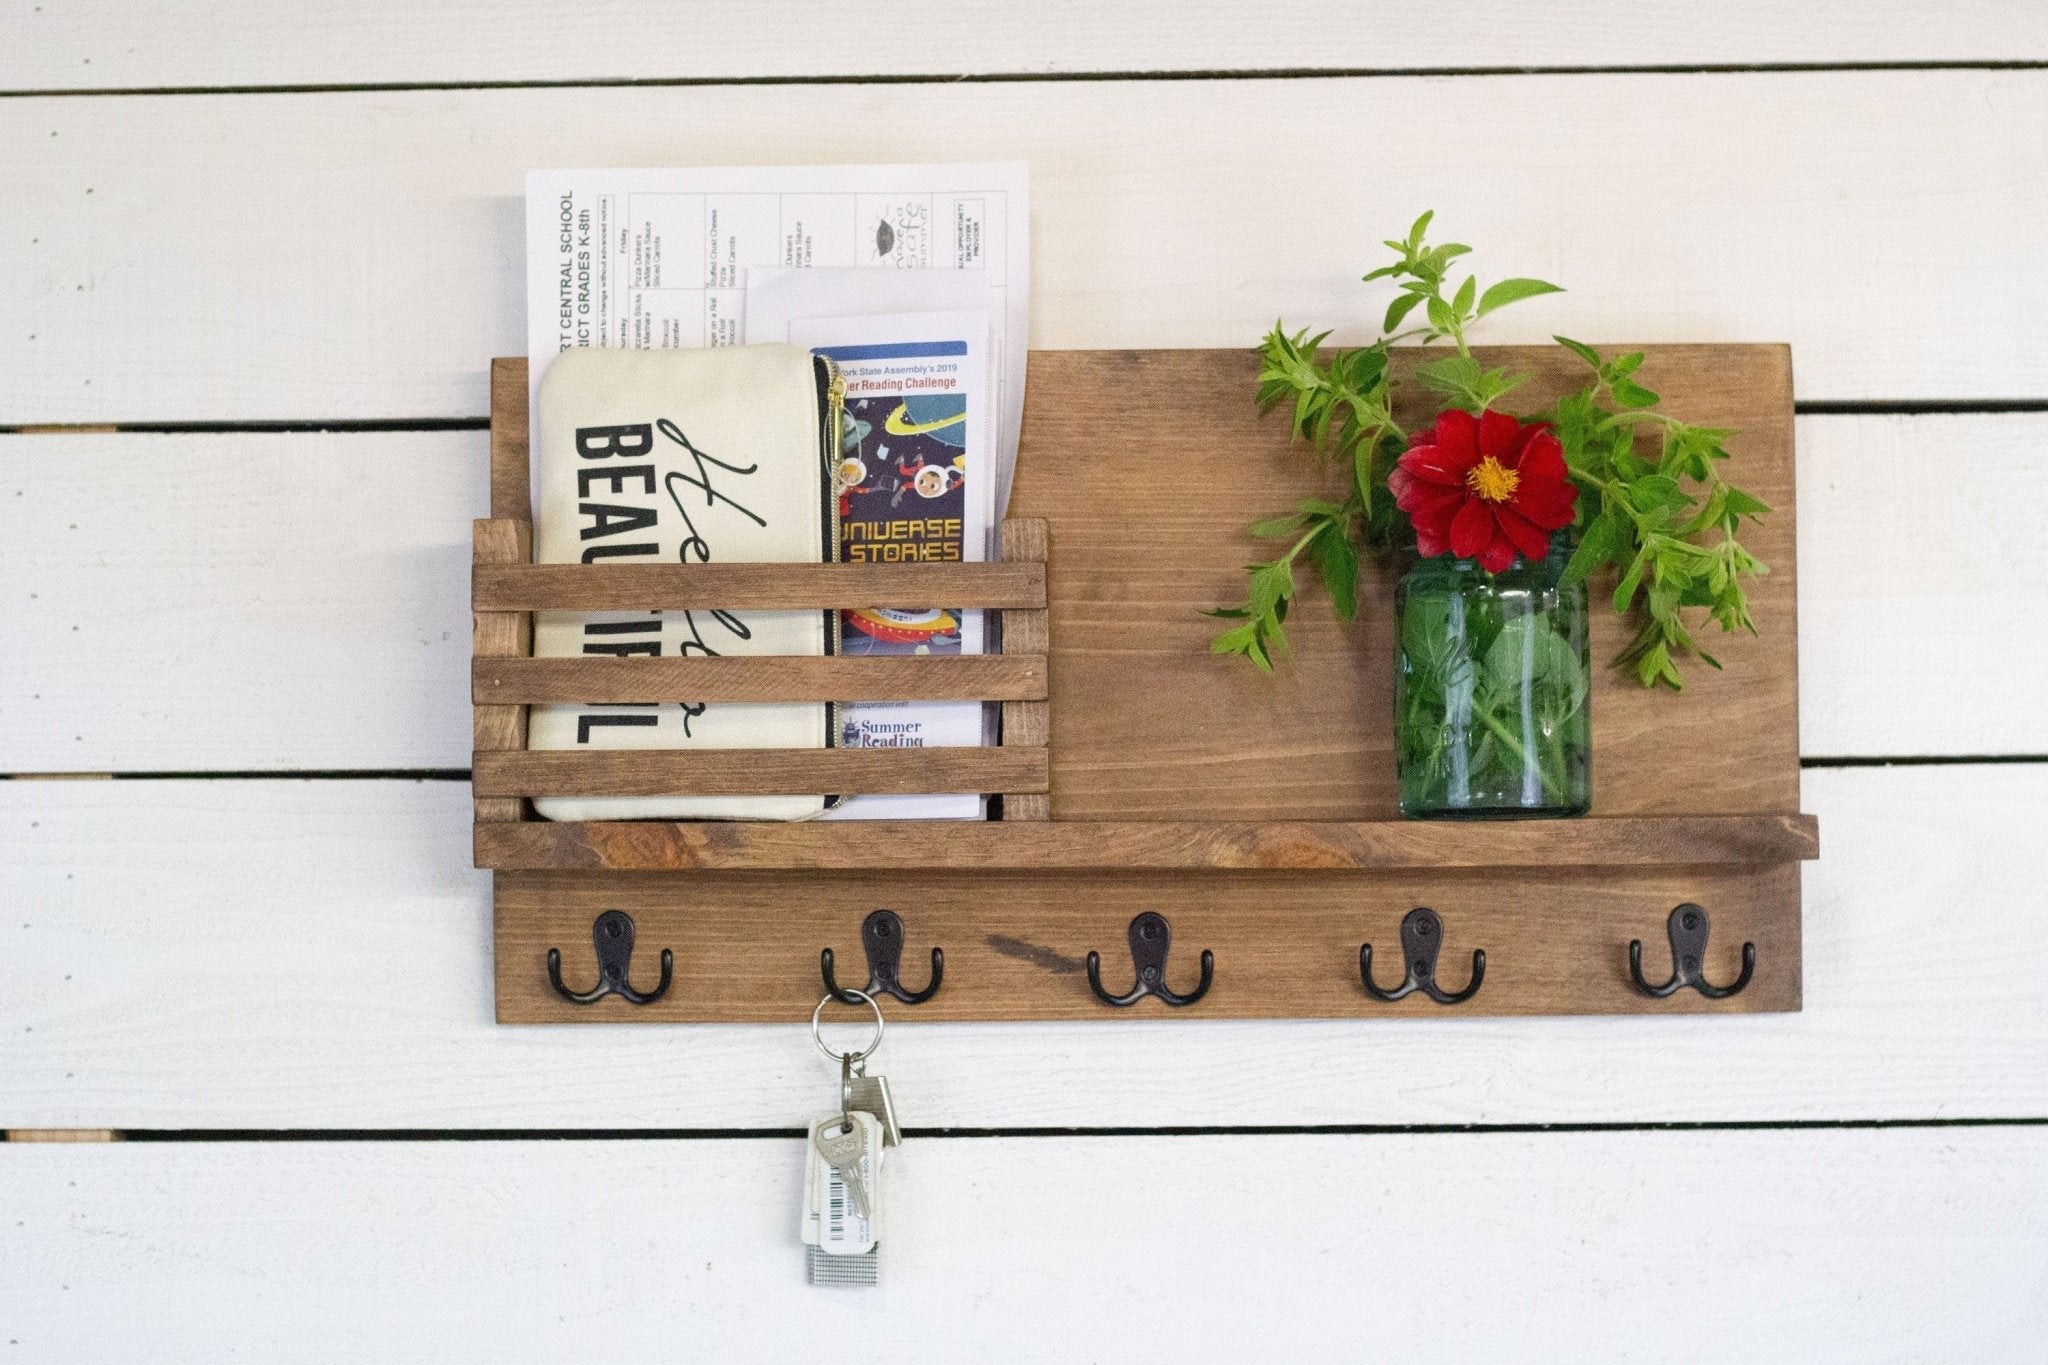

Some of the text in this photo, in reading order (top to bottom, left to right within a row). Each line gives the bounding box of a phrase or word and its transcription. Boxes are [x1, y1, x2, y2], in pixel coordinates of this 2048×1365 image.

[560, 191, 572, 253] SCHOOL
[578, 209, 590, 247] K-8th
[620, 229, 629, 253] Friday
[898, 202, 920, 269] safe
[653, 236, 661, 262] Carrots
[560, 259, 572, 328] CENTRAL
[578, 251, 590, 314] GRADES
[600, 290, 608, 317] change
[860, 367, 882, 376] State
[884, 365, 935, 376] Assembly's
[937, 364, 957, 372] 2019
[847, 377, 956, 391] er Reading Challenge
[841, 519, 960, 540] UNIVERSE
[850, 542, 960, 562] STORIES
[576, 423, 662, 743] BEAUIFL
[862, 720, 921, 733] Summer
[862, 734, 923, 747] Reading
